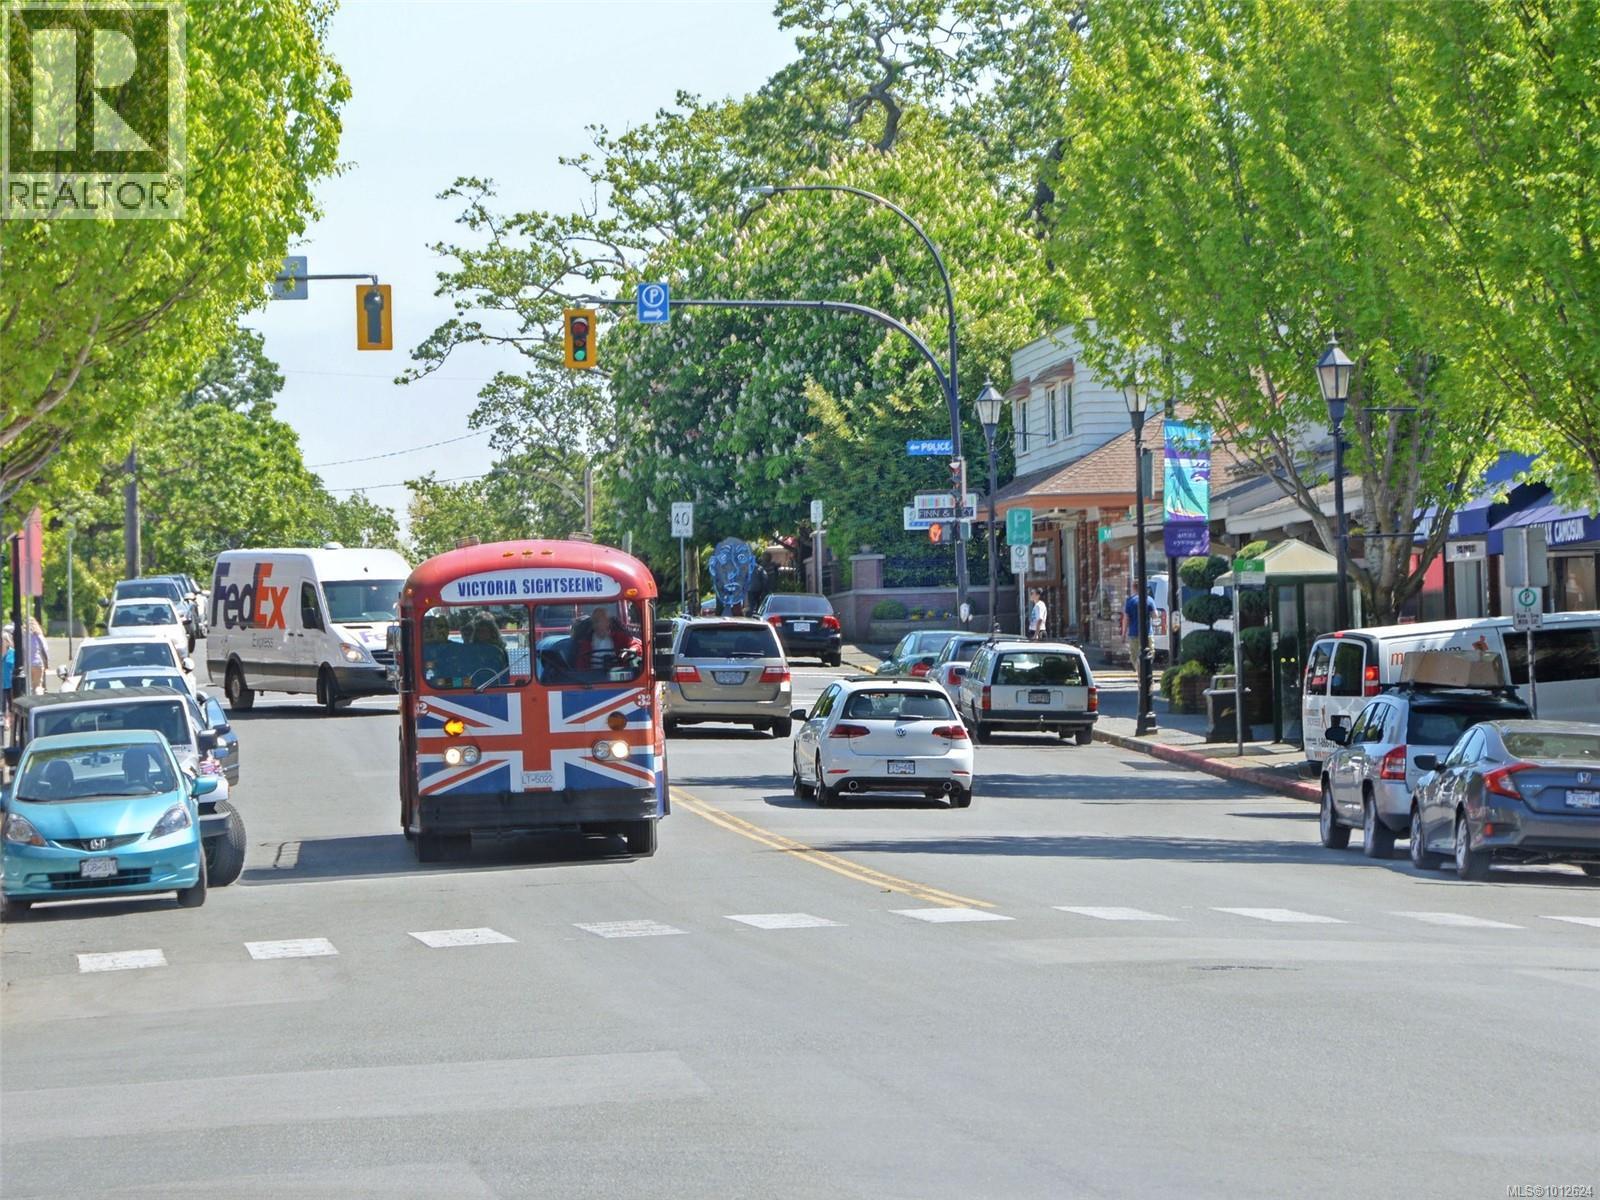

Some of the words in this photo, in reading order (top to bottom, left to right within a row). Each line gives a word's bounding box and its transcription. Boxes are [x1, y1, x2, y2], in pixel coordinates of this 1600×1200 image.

[920, 442, 951, 452] POLICE
[674, 512, 690, 527] 40
[919, 509, 940, 518] FINN
[942, 509, 950, 517] &
[457, 579, 518, 598] VICTORIA
[522, 576, 604, 595] SIGHTSEEING
[211, 562, 290, 631] FedEx
[637, 694, 652, 706] 32
[521, 774, 554, 785] LT-5022
